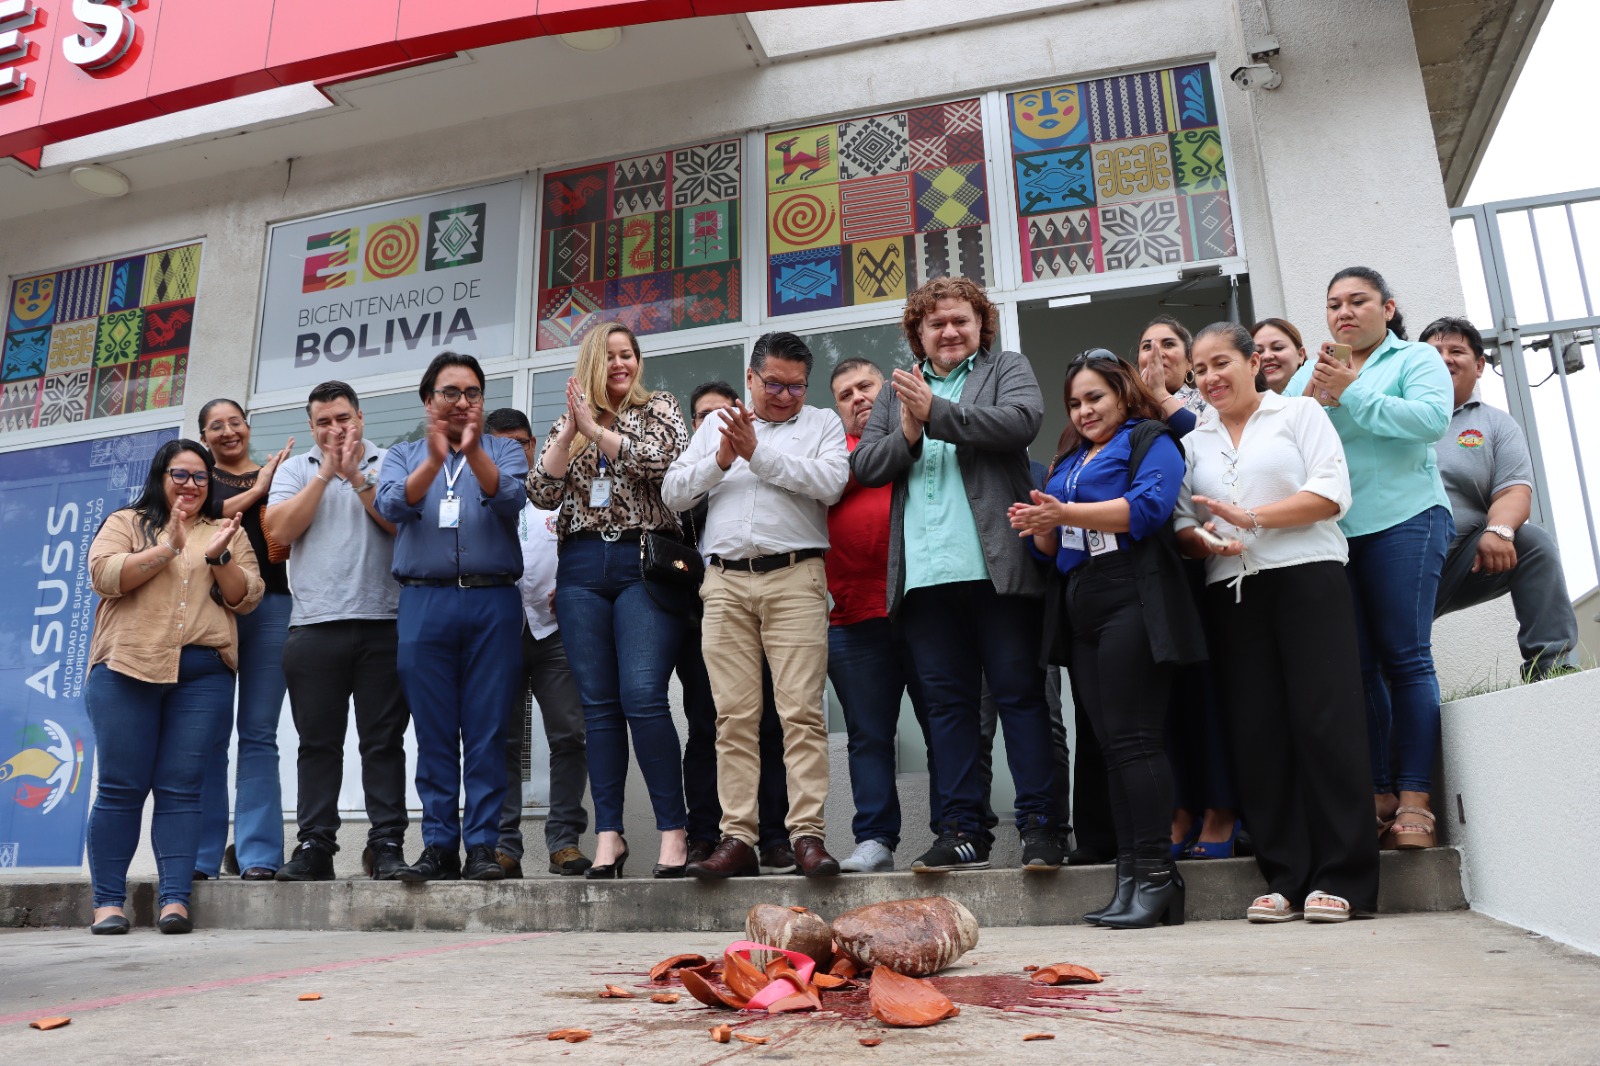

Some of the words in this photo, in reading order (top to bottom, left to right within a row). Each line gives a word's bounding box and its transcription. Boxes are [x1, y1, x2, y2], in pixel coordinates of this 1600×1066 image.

[298, 286, 444, 327] BICENTENARIO
[453, 279, 481, 301] DE
[294, 307, 478, 369] BOLIVIA
[83, 517, 92, 532] DE
[85, 500, 94, 515] LA
[25, 502, 79, 699] ASUSS
[71, 612, 80, 628] DE
[62, 630, 77, 698] AUTORIDAD
[73, 633, 87, 698] SEGURIDAD
[80, 591, 92, 631] SOCIAL
